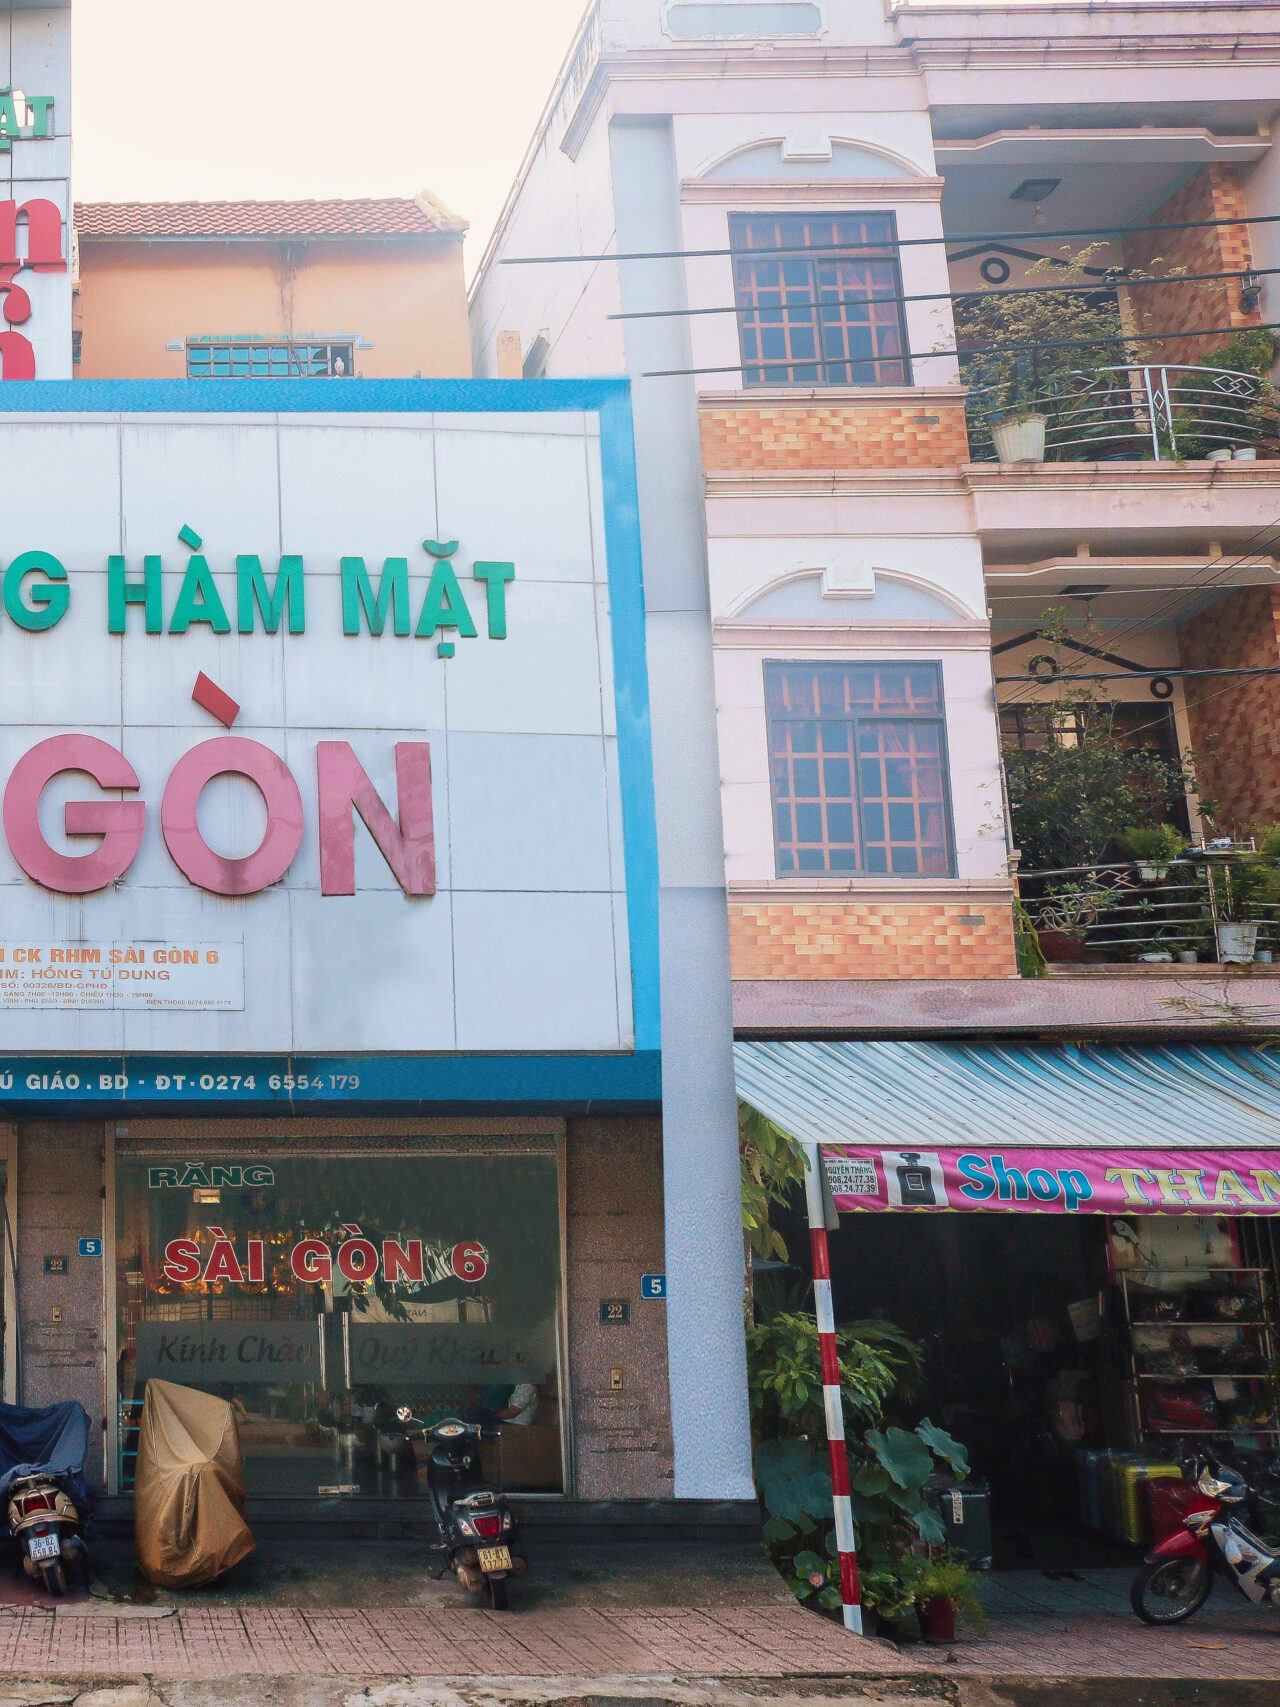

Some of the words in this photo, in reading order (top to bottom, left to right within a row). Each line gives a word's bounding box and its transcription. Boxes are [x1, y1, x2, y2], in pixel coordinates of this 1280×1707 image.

[107, 523, 306, 637] HÀM
[339, 539, 516, 659] MẶT
[2, 670, 436, 897] GÒN
[12, 948, 42, 963] CK
[50, 948, 101, 964] RHM
[108, 946, 145, 964] SÀI
[153, 946, 199, 964] GÒN
[206, 950, 220, 965] 6
[118, 969, 170, 981] DUNG
[26, 1070, 80, 1090] GIÁO
[99, 1074, 129, 1090] BD
[269, 1074, 324, 1090] 6554
[328, 1074, 360, 1090] 179
[148, 1162, 275, 1189] RĂNG
[956, 1154, 1094, 1211] Shop
[86, 1242, 96, 1253] 5
[163, 1226, 265, 1283] SÀI
[290, 1223, 424, 1283] GÒN
[451, 1240, 488, 1283] 6
[651, 1279, 662, 1294] 5
[607, 1304, 624, 1319] 22
